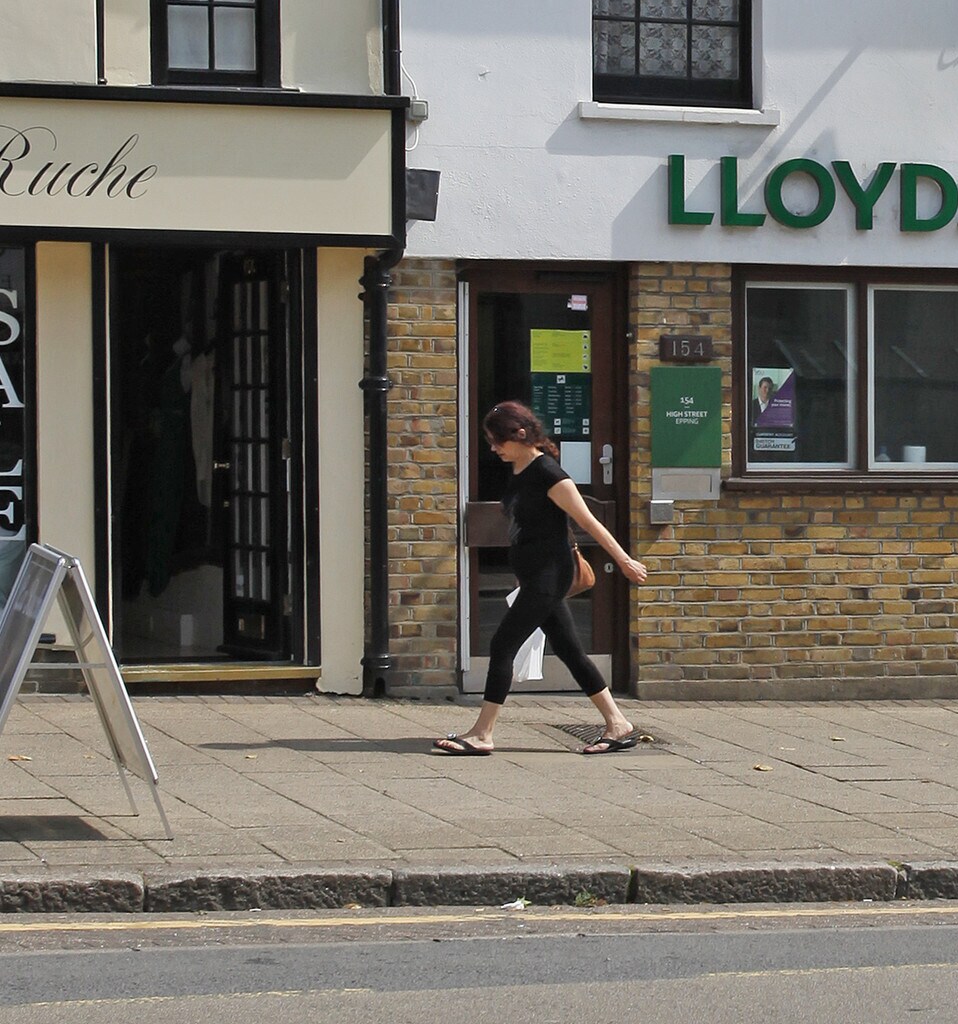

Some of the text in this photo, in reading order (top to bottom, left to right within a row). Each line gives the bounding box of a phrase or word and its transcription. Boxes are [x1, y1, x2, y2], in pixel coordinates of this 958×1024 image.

[672, 340, 705, 356] 154
[680, 396, 694, 405] 154
[666, 410, 708, 418] HIGH STREET
[675, 417, 699, 425] EPPING
